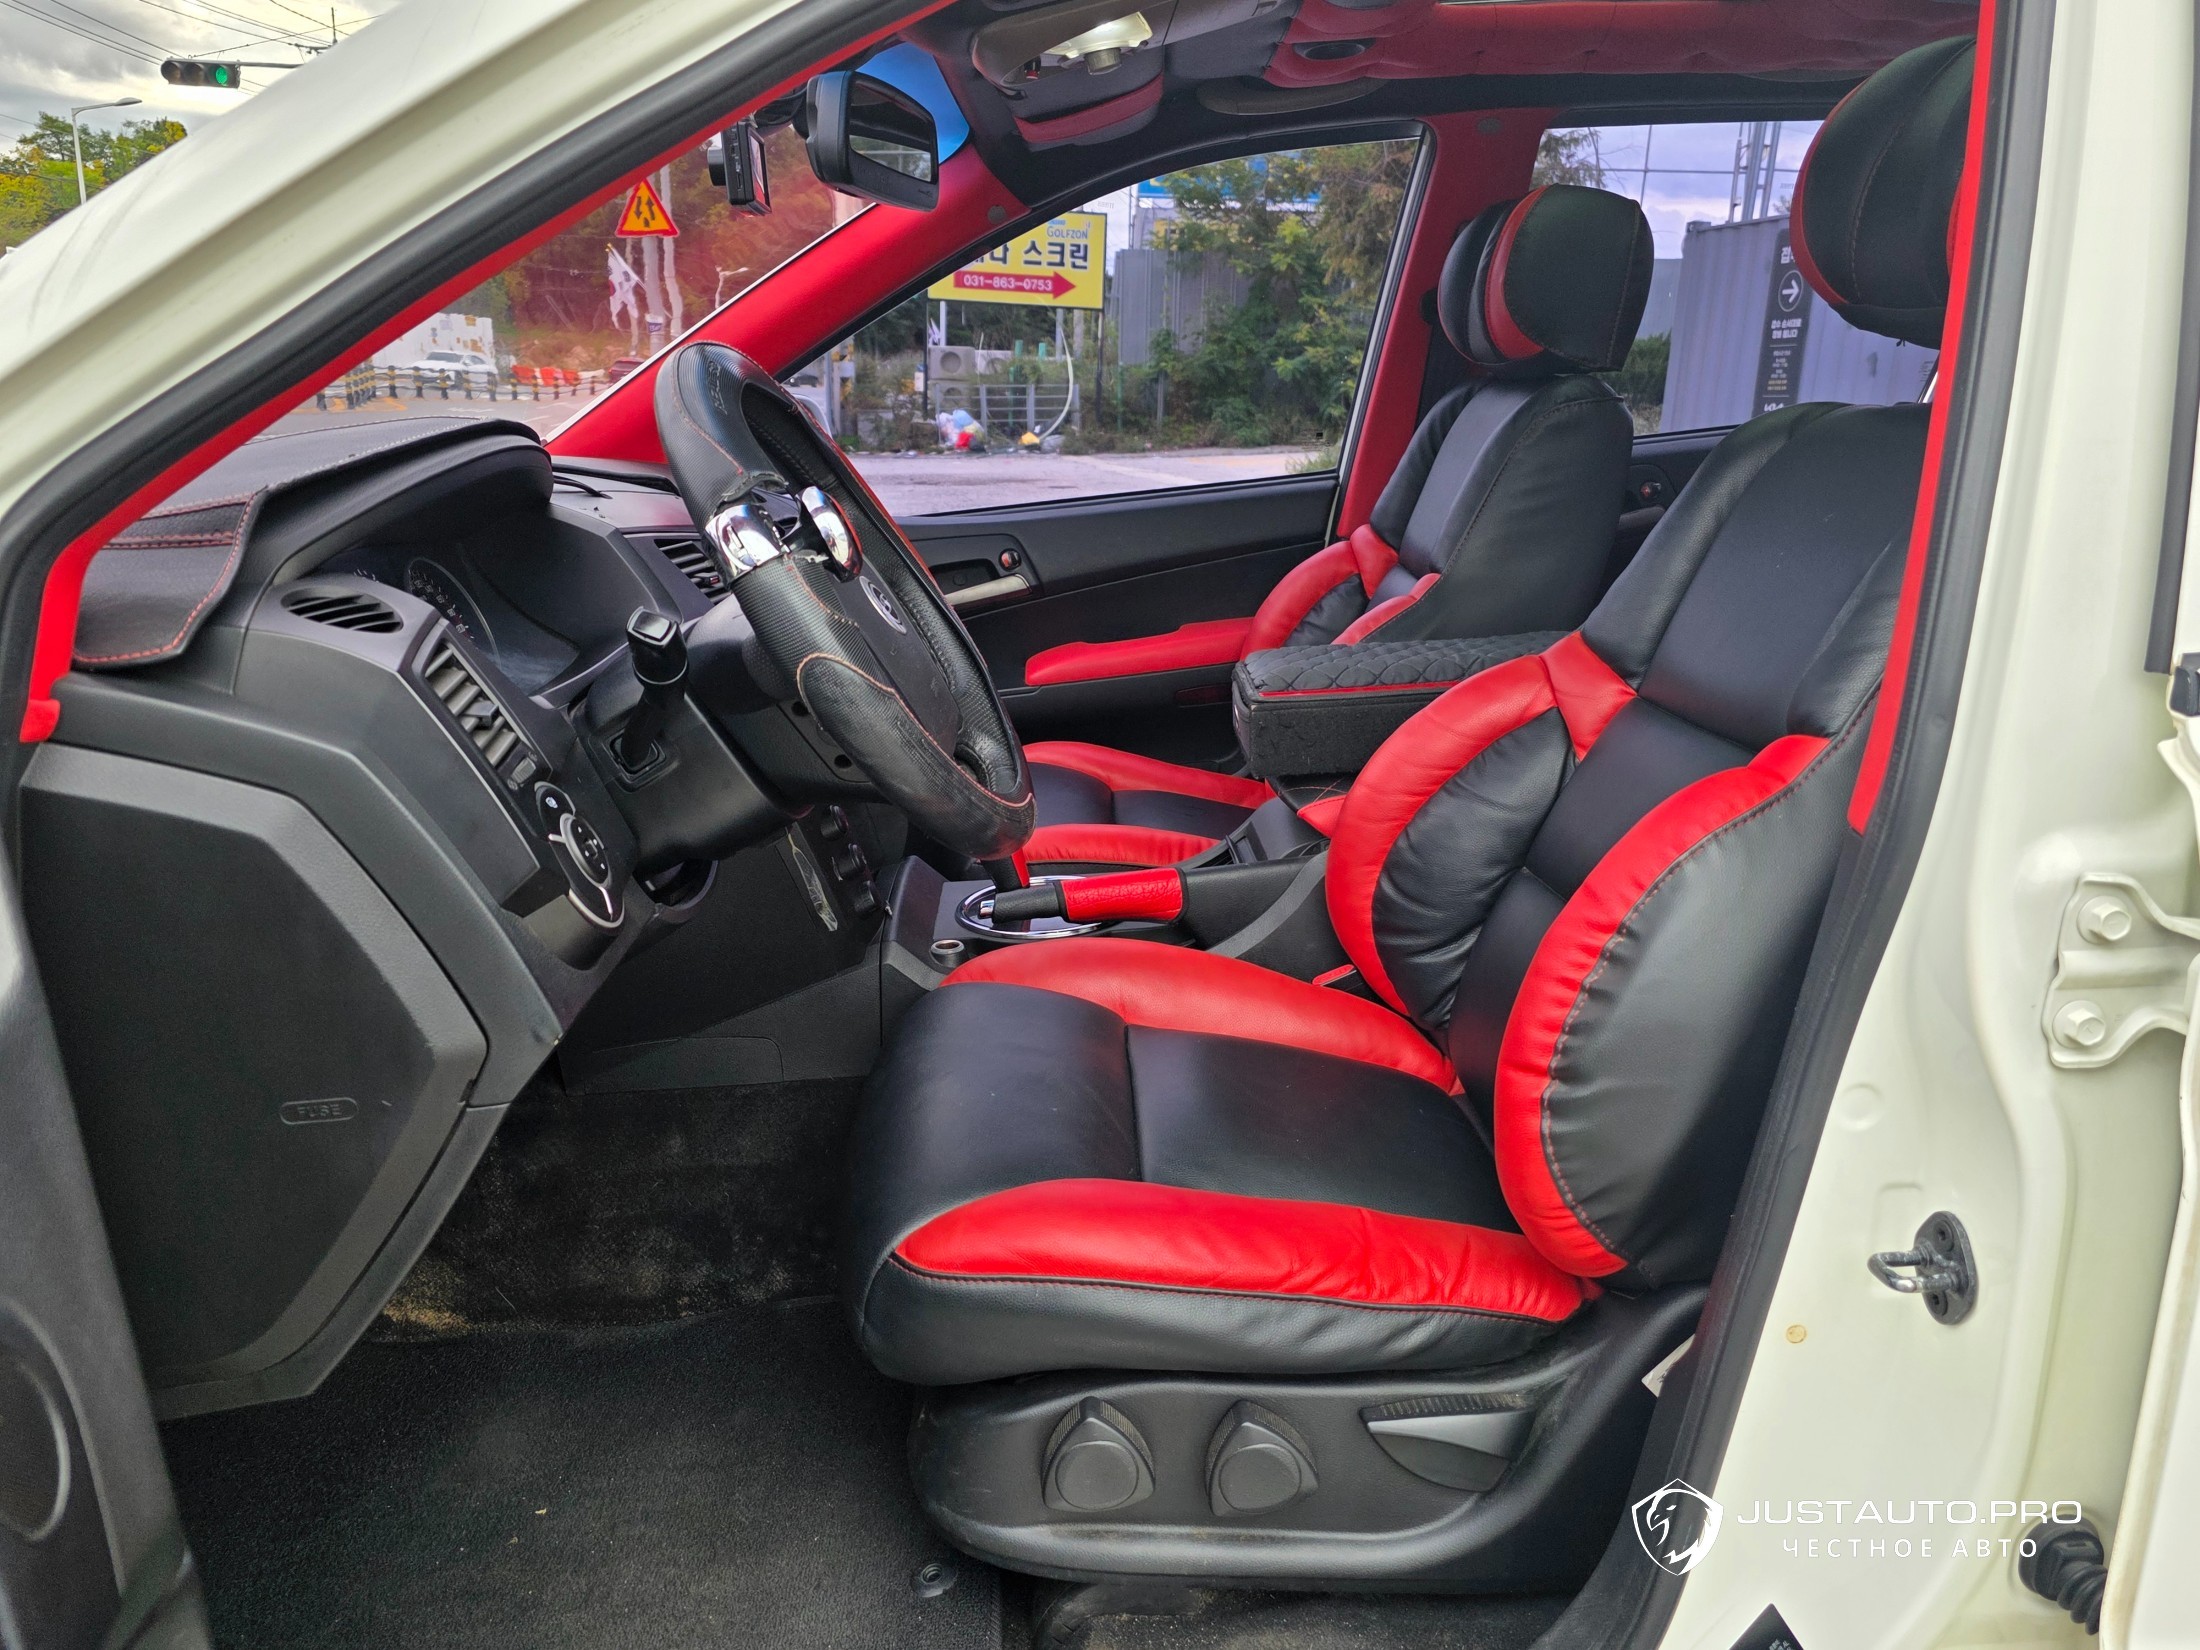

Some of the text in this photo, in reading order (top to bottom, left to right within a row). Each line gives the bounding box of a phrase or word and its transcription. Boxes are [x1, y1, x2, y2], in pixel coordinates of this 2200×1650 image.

[1047, 225, 1088, 239] GOLFZON
[975, 240, 1088, 269] 나 스크린
[963, 274, 1053, 292] 031-863-0753
[297, 1104, 343, 1118] FUSE
